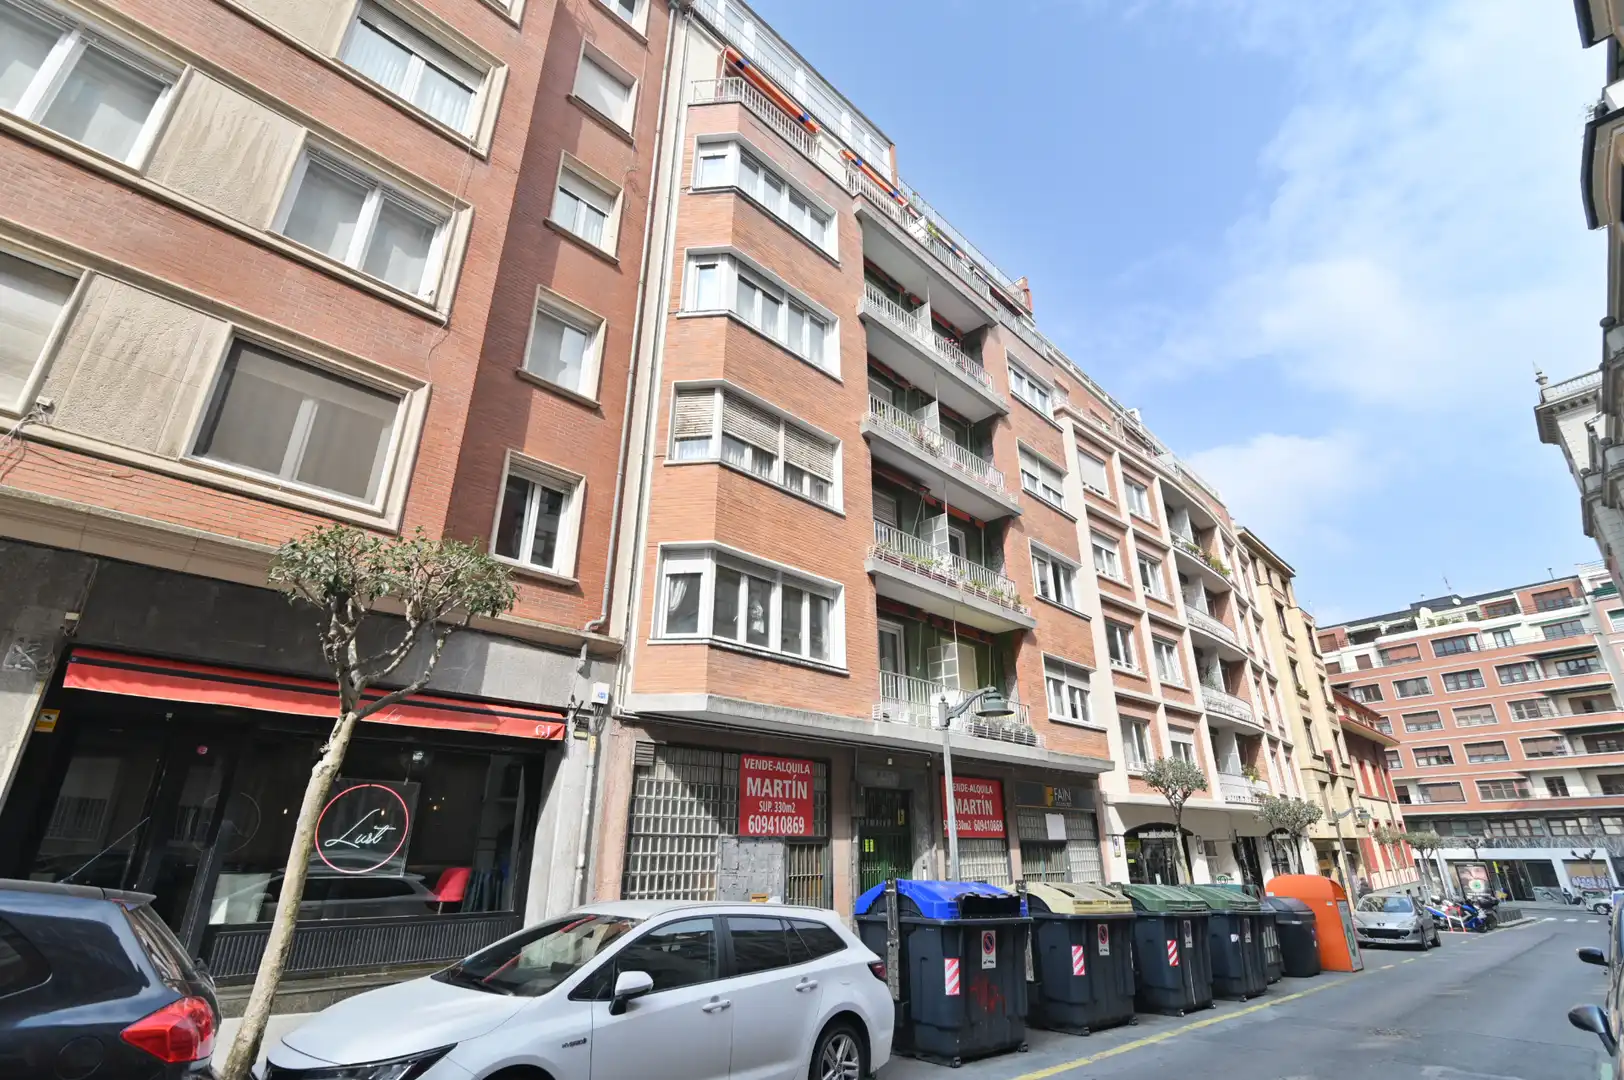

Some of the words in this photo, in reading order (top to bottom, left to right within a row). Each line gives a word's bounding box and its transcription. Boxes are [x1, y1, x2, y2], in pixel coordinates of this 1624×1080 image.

[744, 758, 810, 774] VENDE-ALQUILA
[746, 775, 808, 799] MARTÍN
[953, 783, 994, 795] ENDE-ALQUILA
[758, 800, 773, 813] SUP.
[774, 801, 796, 813] 330m2
[324, 808, 396, 848] Lust
[748, 814, 805, 834] 609410869
